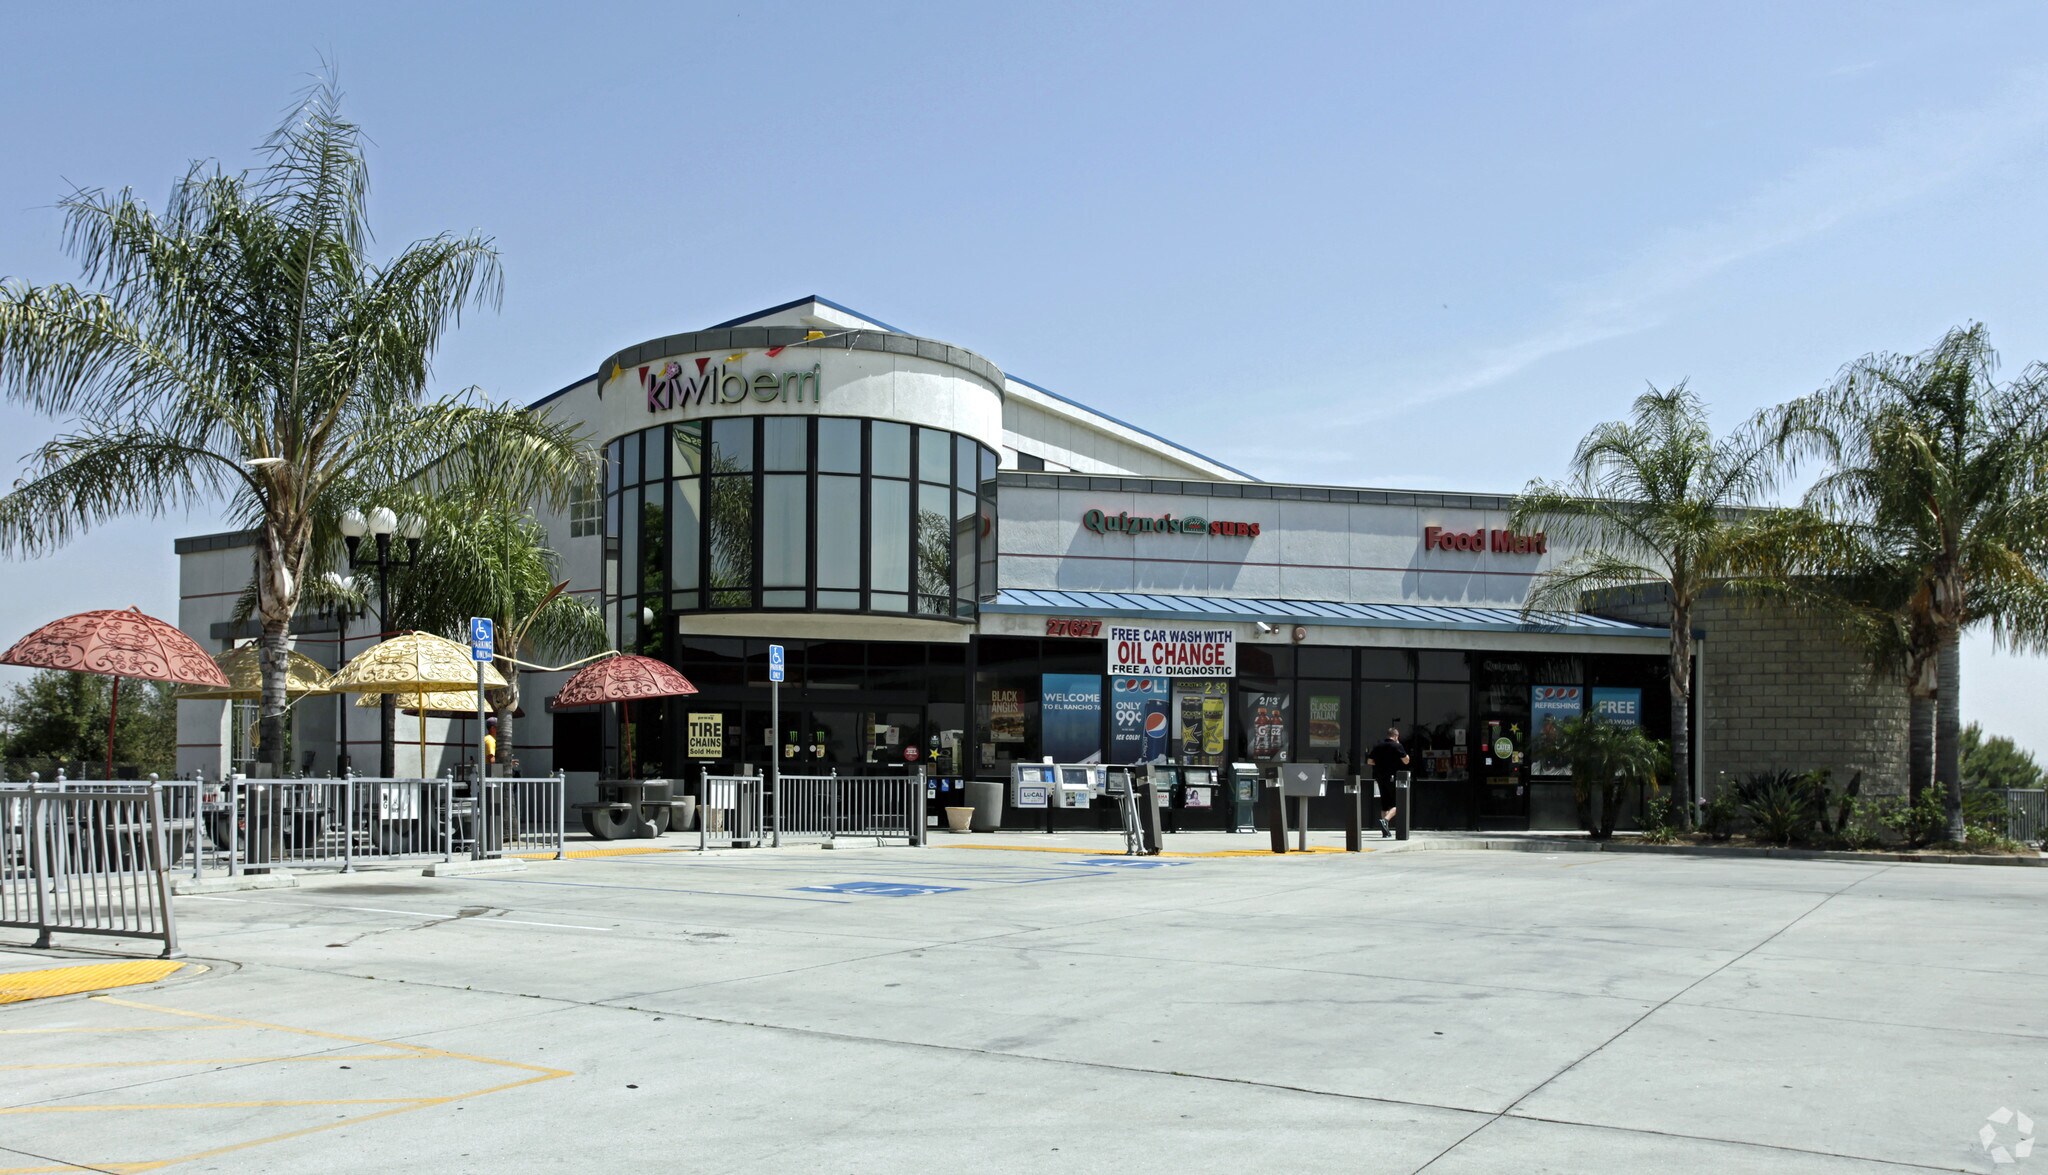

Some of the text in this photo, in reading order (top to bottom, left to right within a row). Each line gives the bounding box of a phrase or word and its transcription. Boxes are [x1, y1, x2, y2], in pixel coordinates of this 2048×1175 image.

[648, 362, 821, 413] kiwiberri
[1083, 508, 1180, 535] Quizno's
[1425, 526, 1547, 554] Food Mart
[1046, 619, 1102, 637] 27627
[1112, 628, 1232, 643] FREE CAR WASH WITH
[1117, 641, 1225, 666] OIL CHANGE
[1112, 665, 1140, 674] FREE
[1166, 666, 1232, 675] DIAGNOSTIC
[991, 690, 1018, 701] BLACK
[1044, 693, 1100, 702] WELCOME
[991, 702, 1018, 712] ANGUS
[1115, 702, 1141, 710] ONLY
[1310, 703, 1338, 711] CLASSIC
[1599, 701, 1635, 714] FREE
[1115, 710, 1142, 726] 99¢
[1310, 712, 1336, 720] ITALIAN
[690, 722, 721, 737] TIRE
[690, 738, 721, 747] CHAINS
[1280, 751, 1287, 759] G
